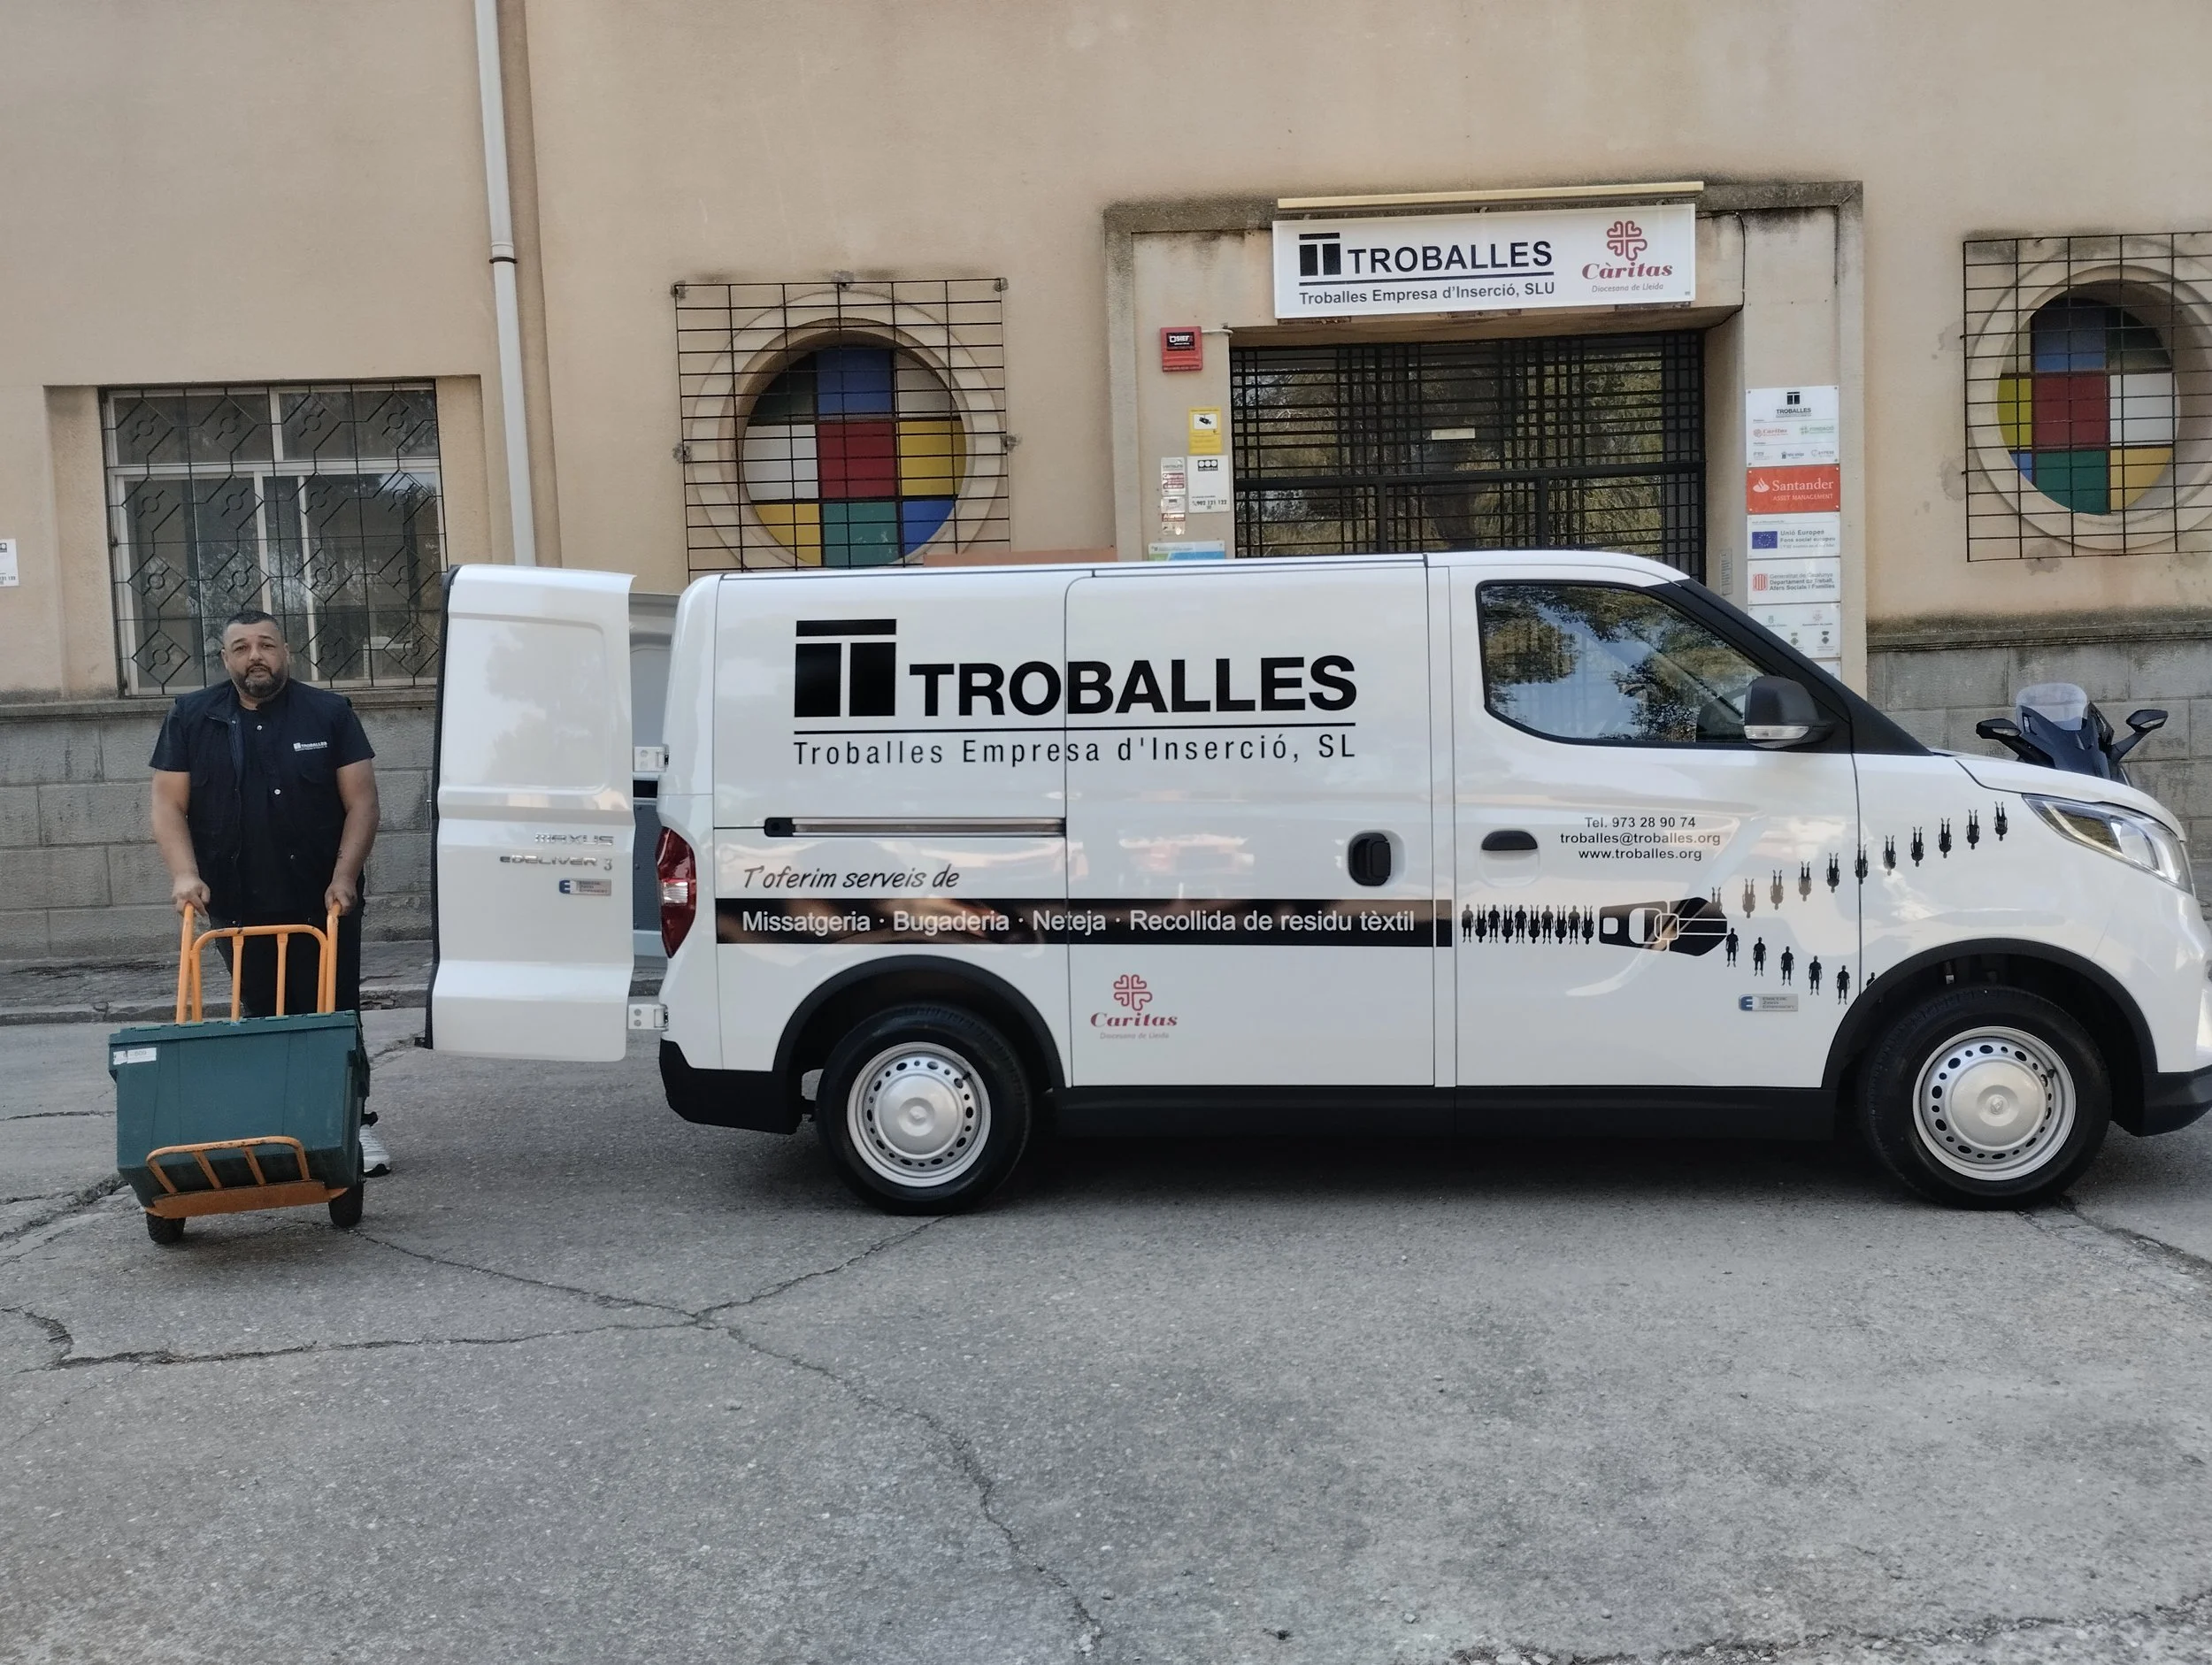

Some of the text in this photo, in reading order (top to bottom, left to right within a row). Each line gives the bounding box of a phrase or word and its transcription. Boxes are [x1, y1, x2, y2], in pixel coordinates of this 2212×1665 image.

[1347, 241, 1553, 274] TROBALLES
[1582, 261, 1673, 280] Càritas
[1299, 289, 1368, 305] Troballes
[1372, 288, 1438, 303] Empresa
[1525, 281, 1555, 295] SLU
[1592, 284, 1629, 293] Diocesana
[1642, 282, 1663, 291] Lleida
[1772, 478, 1834, 492] Santander
[910, 655, 1357, 717] TROBALLES
[794, 733, 1356, 767] Troballes Empresa d'Inserció, SL
[1586, 817, 1696, 828] Tel. 973 28 90 74
[1561, 832, 1721, 846] troballes@troballes.org
[1578, 848, 1702, 861] www.troballes.org
[603, 858, 613, 871] 3
[842, 868, 926, 888] serveis
[932, 863, 960, 888] de
[741, 909, 1415, 937] Missatgeria Bugaderia Neteja Recollida de residu tèxtil
